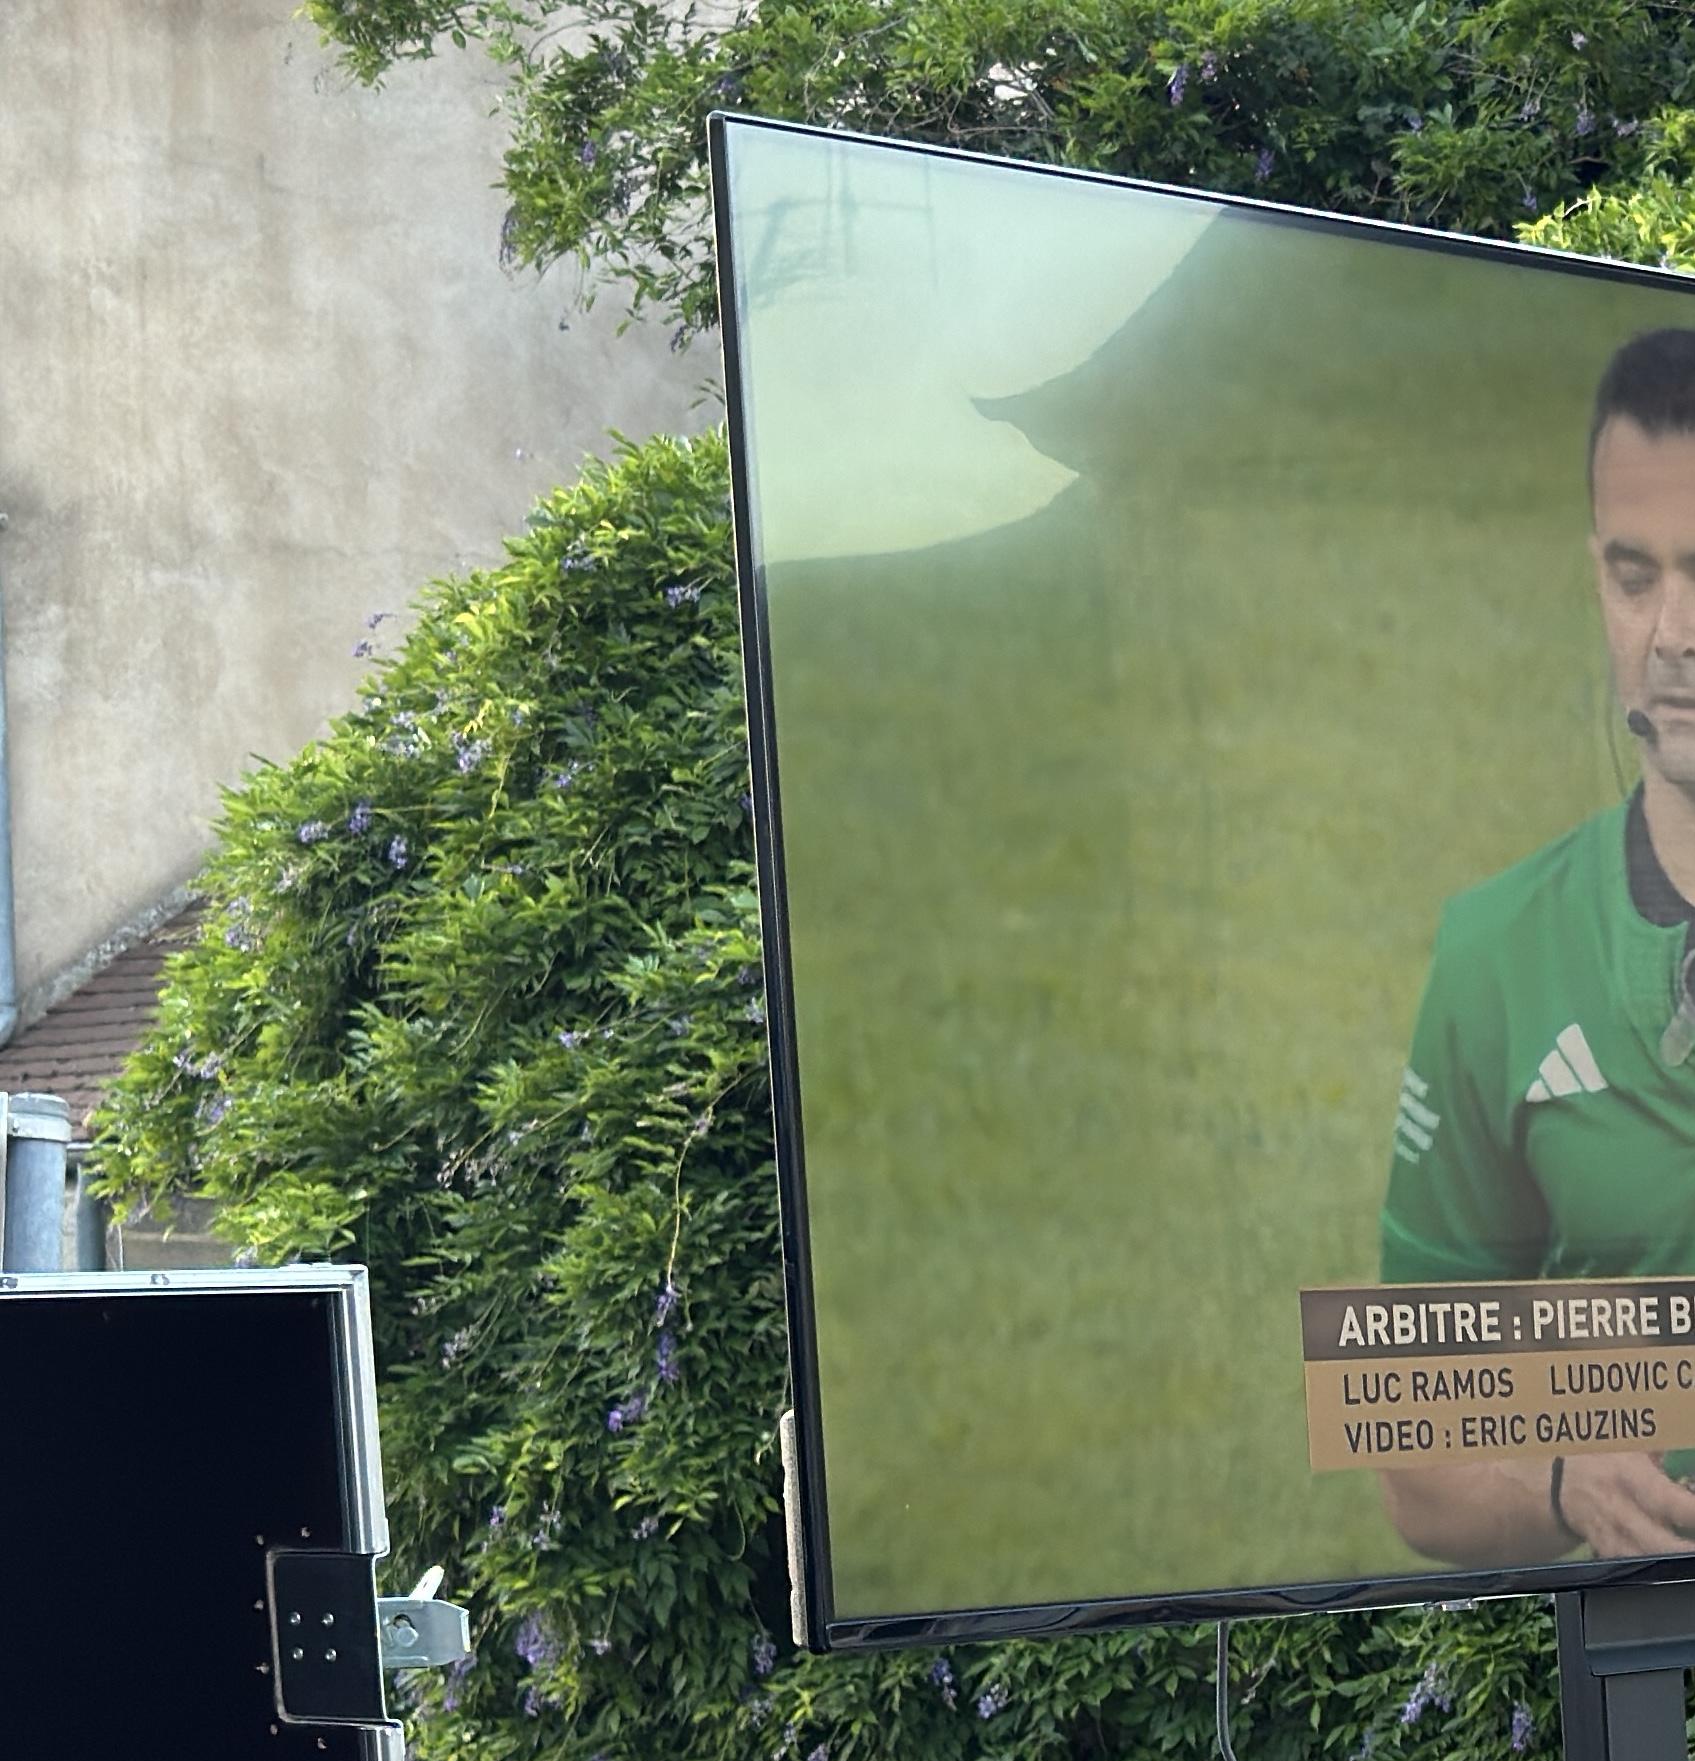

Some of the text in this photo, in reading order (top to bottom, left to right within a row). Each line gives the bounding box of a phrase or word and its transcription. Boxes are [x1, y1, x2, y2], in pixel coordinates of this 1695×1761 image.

[1338, 1301, 1502, 1347] ARBITRE
[1532, 1296, 1661, 1340] PIERRE
[1343, 1372, 1402, 1406] LUC
[1411, 1367, 1514, 1403] RAMOS
[1550, 1360, 1668, 1396] LUDOVIC
[1344, 1419, 1434, 1454] VIDEO
[1461, 1414, 1527, 1448] ERIC
[1535, 1407, 1657, 1443] GAUZINS
